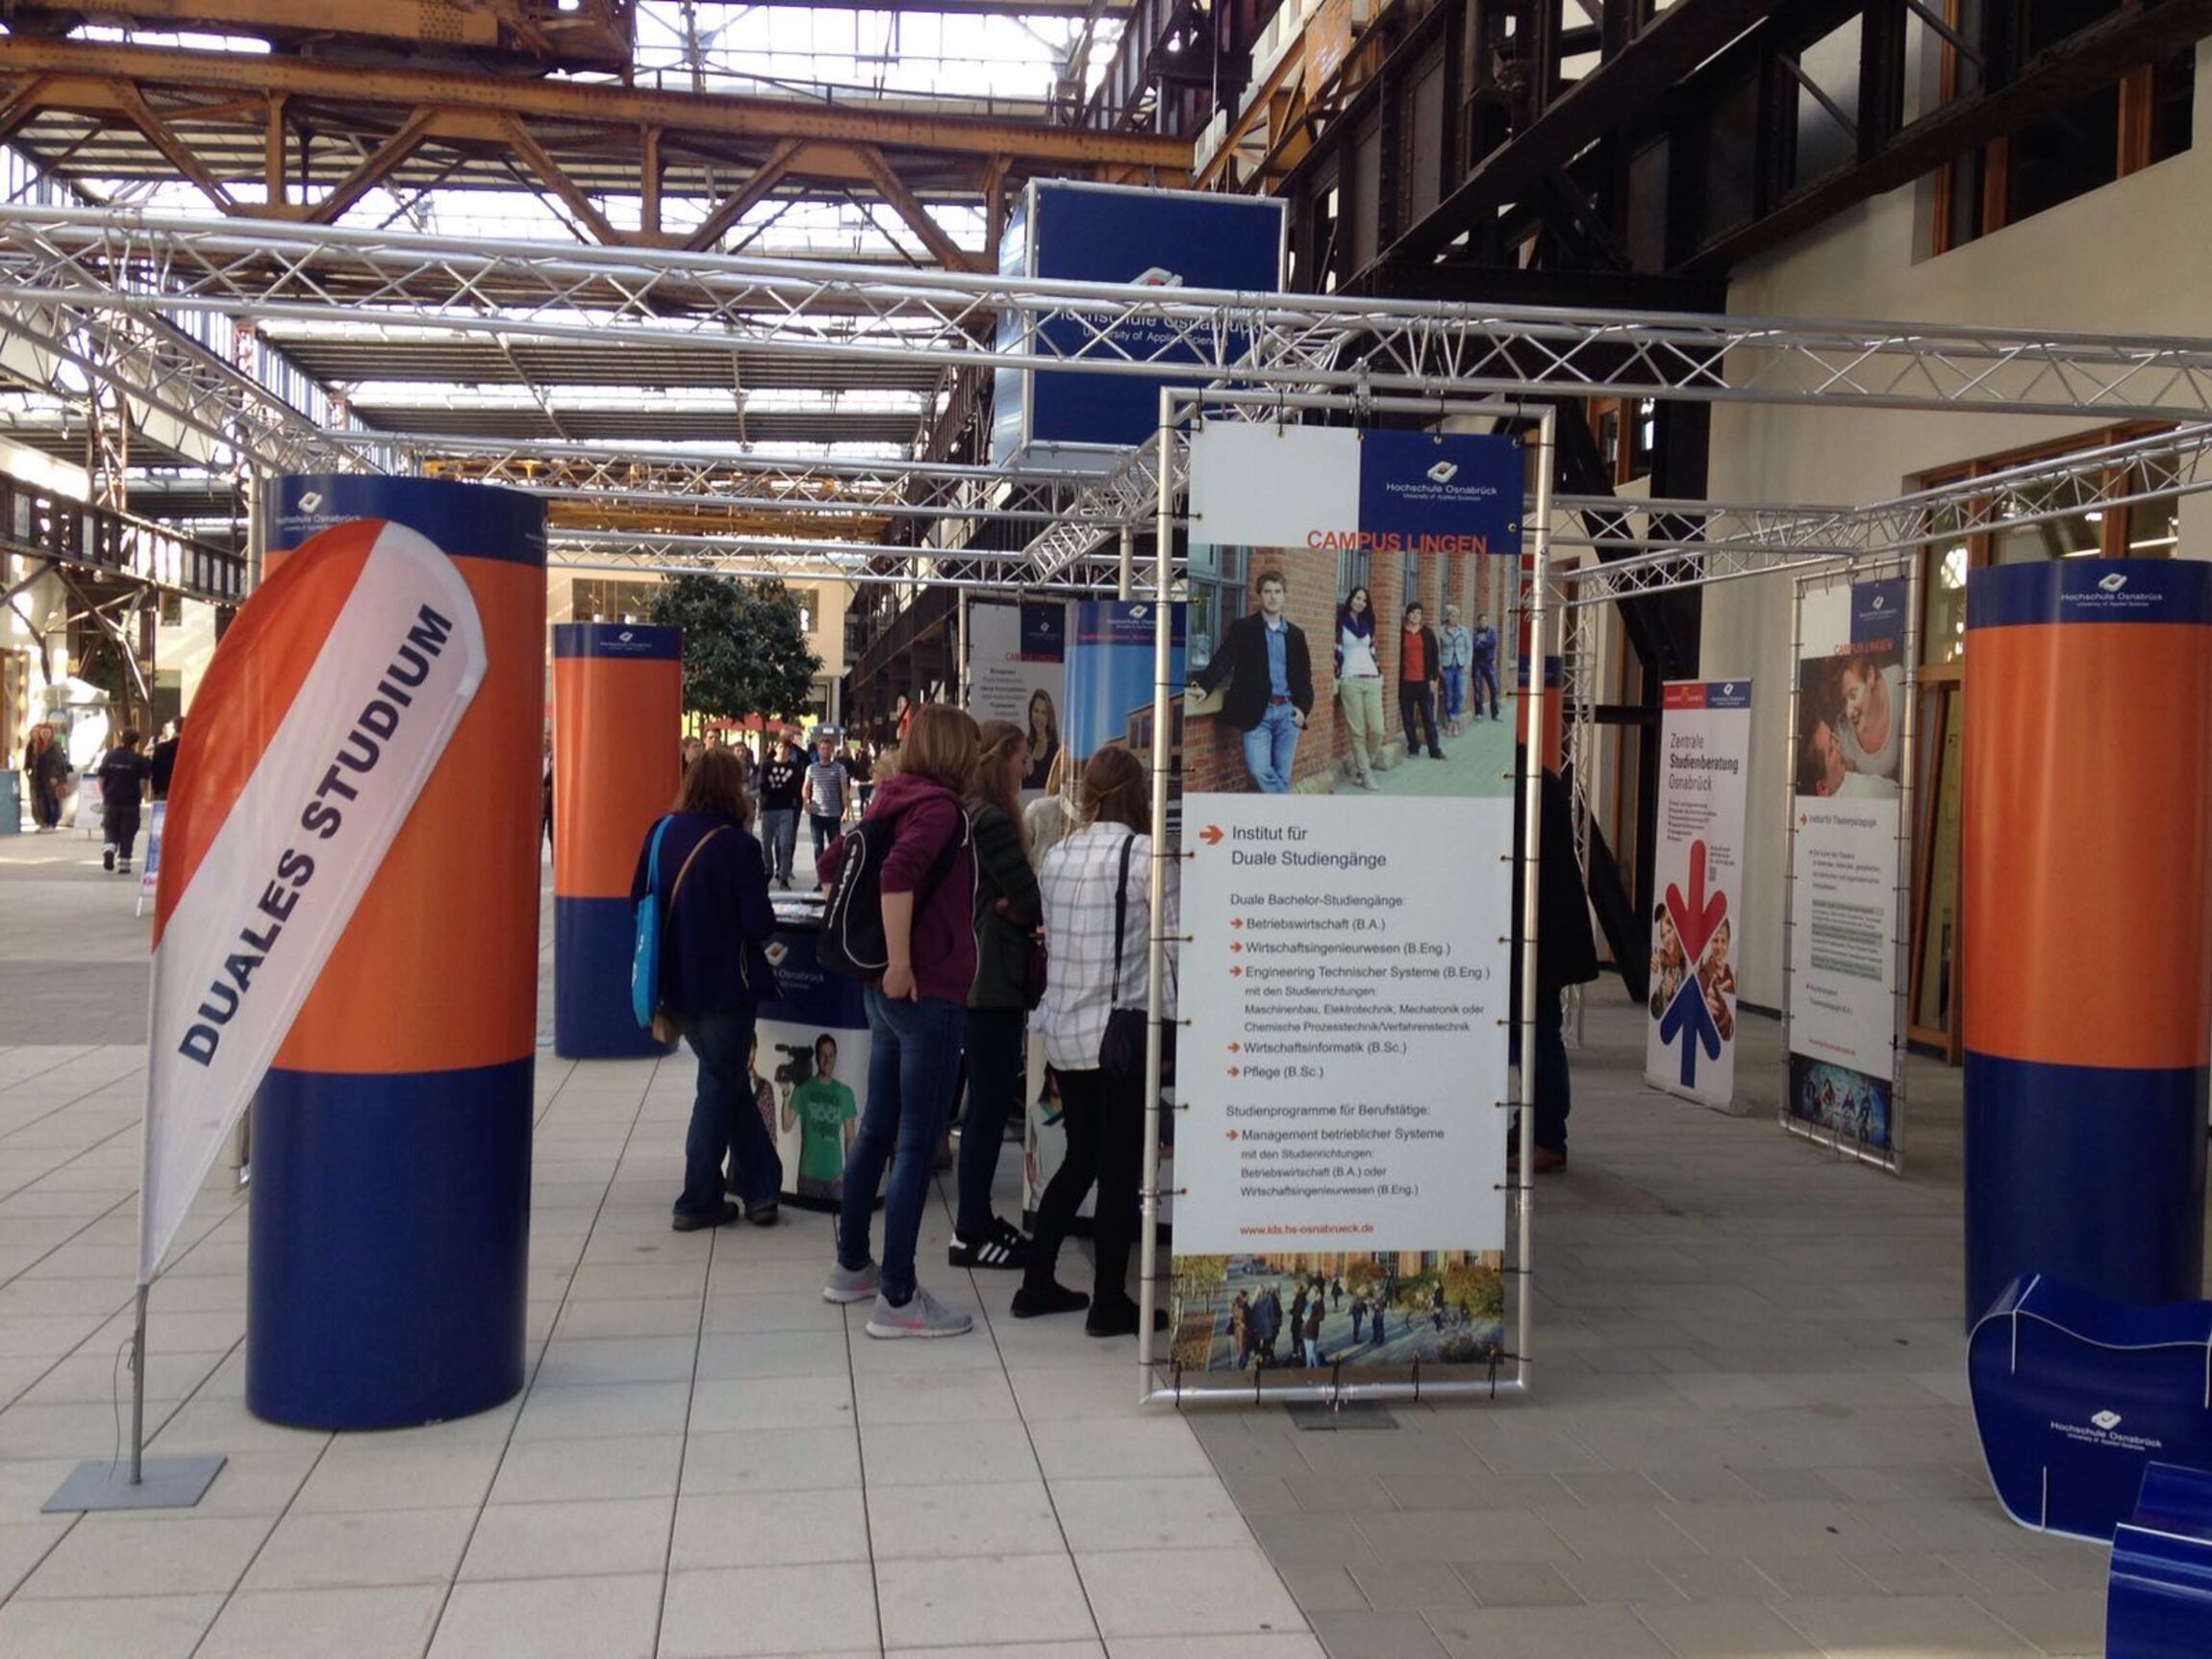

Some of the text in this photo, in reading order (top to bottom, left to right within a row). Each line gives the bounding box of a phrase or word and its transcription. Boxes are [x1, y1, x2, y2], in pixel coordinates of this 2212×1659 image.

[1132, 331, 1143, 340] of
[1386, 483, 1497, 495] Hochschule Osnabrück
[1307, 530, 1488, 554] CAMPUS LINGEN
[2061, 592, 2163, 601] Hochschule Osnabrück
[1671, 732, 1704, 748] Zentrale
[1670, 753, 1739, 774] Studienberatung
[1669, 773, 1712, 792] Osnabrück
[177, 603, 454, 1068] DUALES STUDIUM
[1233, 825, 1308, 841] Institut für
[1232, 850, 1387, 869] Duale Studiengänge
[1230, 893, 1265, 905] Duale
[1246, 917, 1386, 933] Betriebswirtschaft (B.A.)
[1245, 942, 1451, 958] Wirtschaftsingenieurwesen (B.Eng.)
[1245, 966, 1491, 981] Engineering Technischer Systeme (B.Eng.)
[1244, 985, 1261, 996] mit
[1263, 986, 1283, 997] den
[1399, 1004, 1460, 1015] Mechatronik
[1462, 1003, 1484, 1016] oder
[1244, 1021, 1470, 1033] Chemische Prozesstechnik/Verfahrenstechnik
[1244, 1041, 1407, 1055] Wirtschaftsinformatik (B.Sc.)
[1243, 1065, 1324, 1080] Pflege (B.Sc.)
[1226, 1104, 1430, 1119] Studienprogramme für Berufstätige:
[1242, 1127, 1445, 1143] Management betrieblicher Systeme
[1241, 1148, 1257, 1160] mit
[1259, 1149, 1279, 1161] den
[1241, 1166, 1387, 1179] Betriebswirtschaft (B.A.) oder
[1241, 1184, 1419, 1197] Wirtschaftsingenieurwesen (B.Eng.)
[2050, 1420, 2162, 1447] Hochschule Osnabrück
